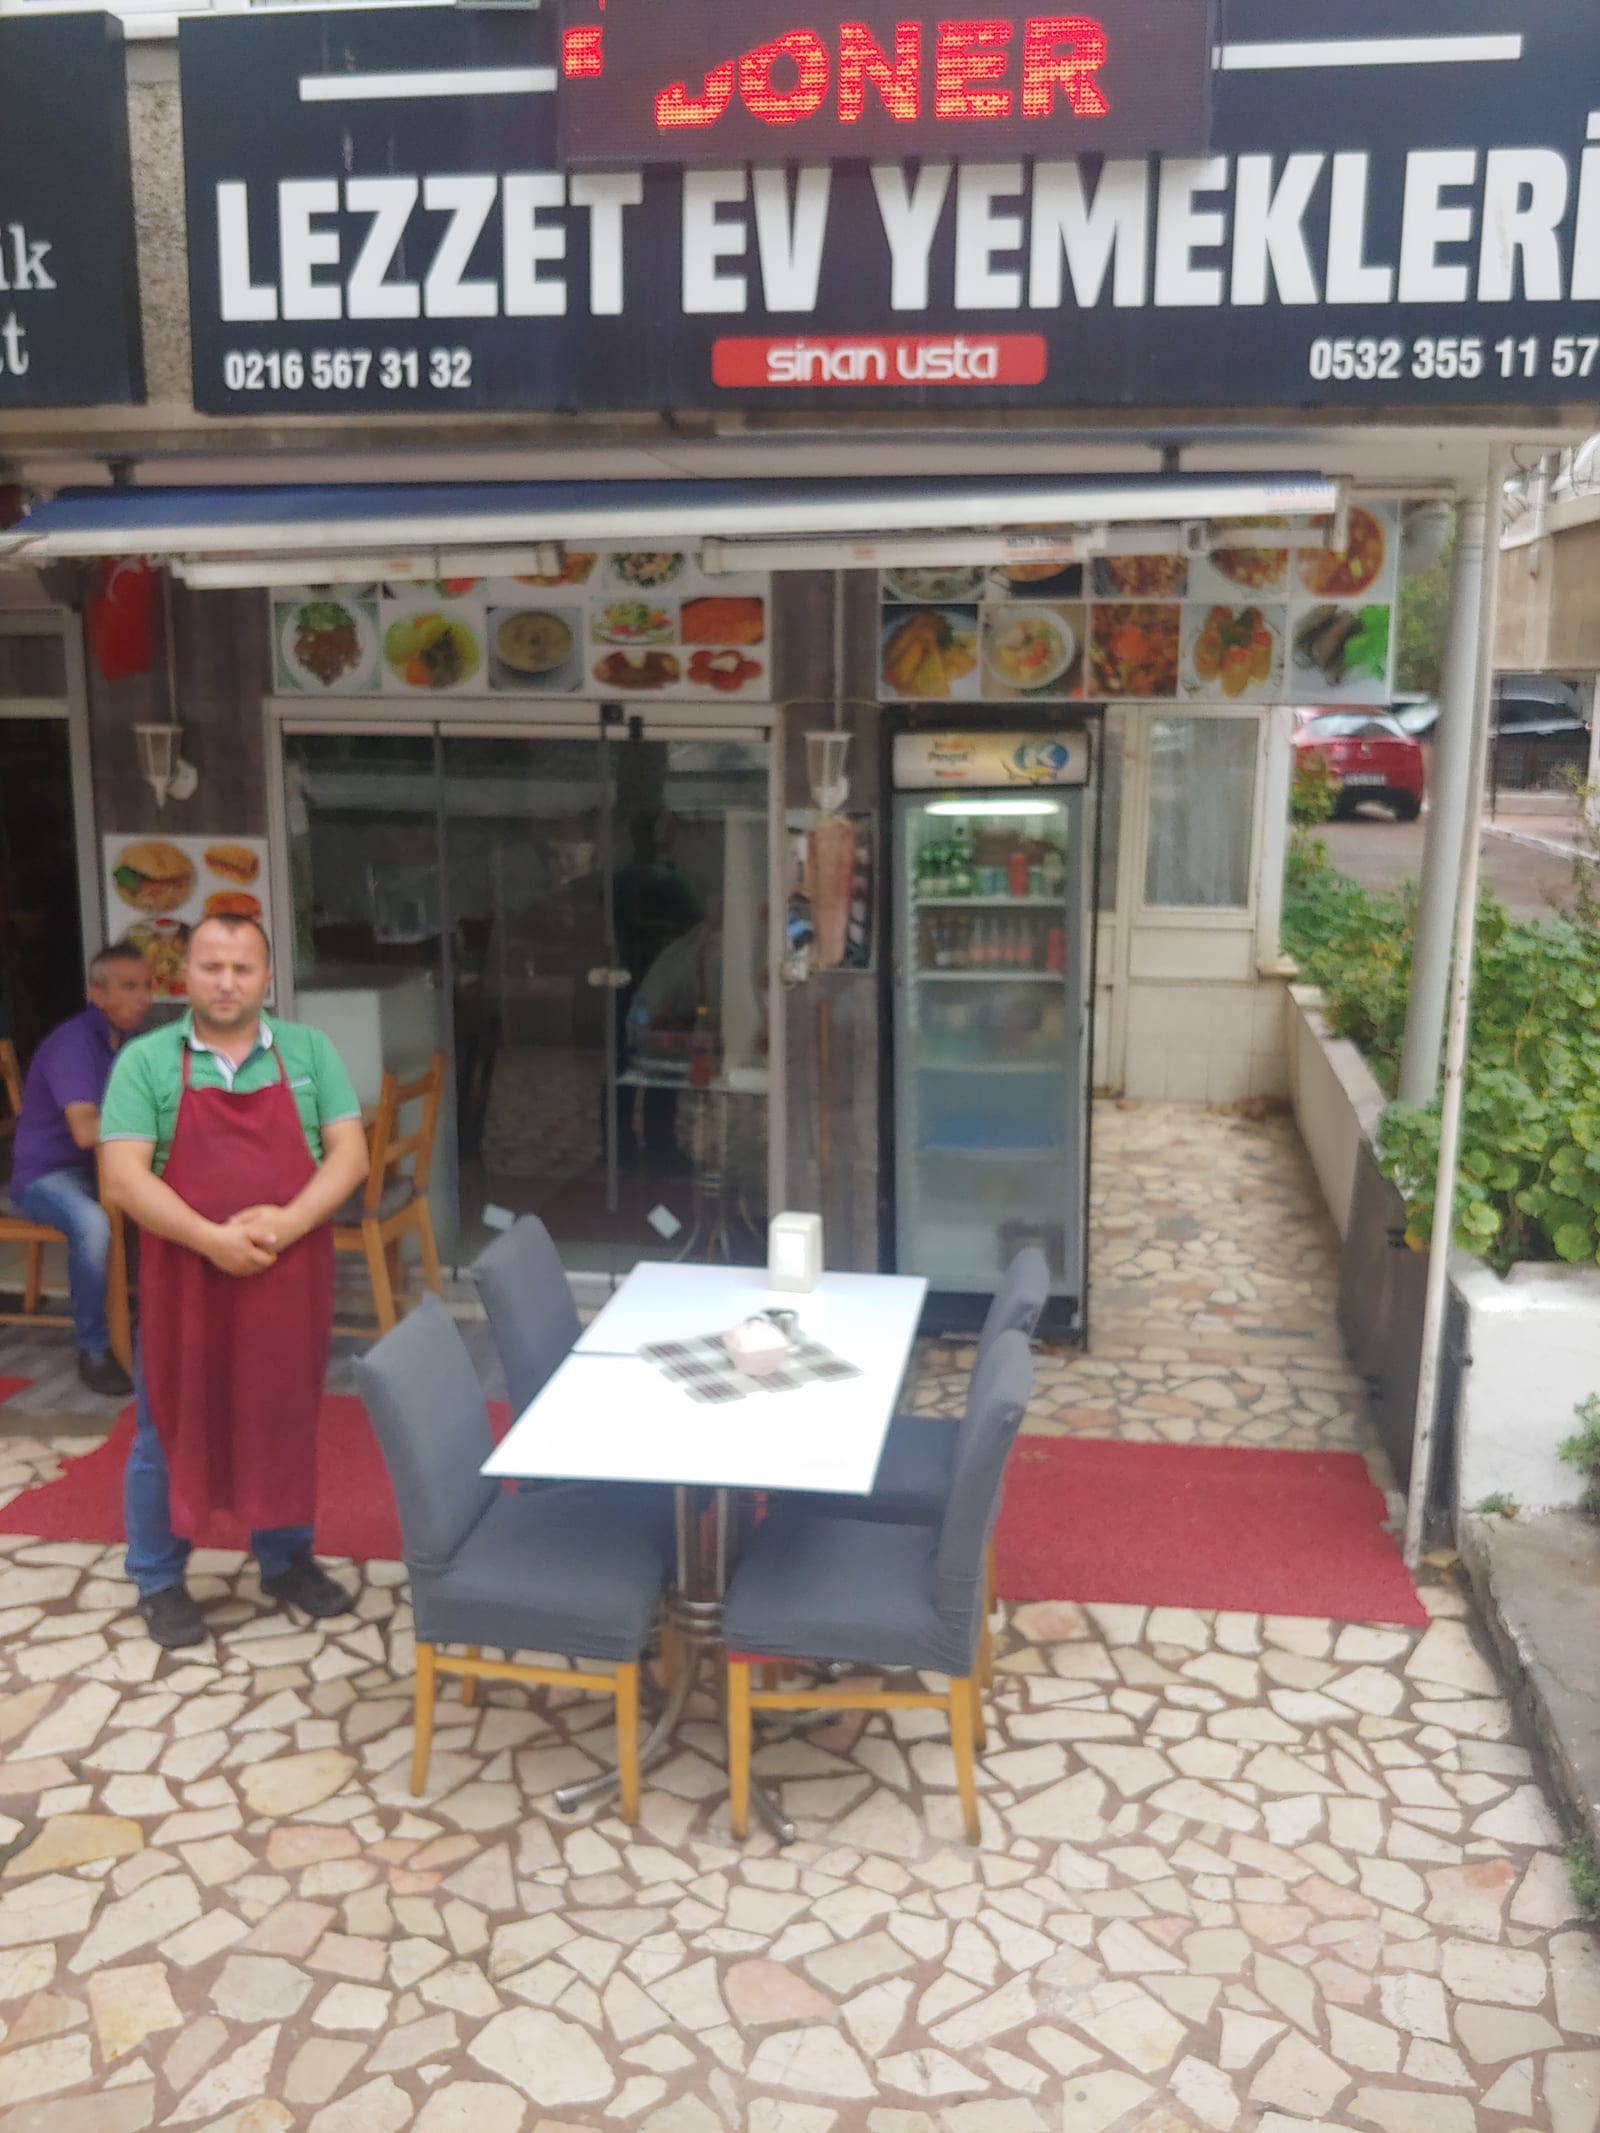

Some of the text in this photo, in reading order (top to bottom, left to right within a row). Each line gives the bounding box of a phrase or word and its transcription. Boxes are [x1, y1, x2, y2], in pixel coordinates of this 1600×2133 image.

[216, 170, 643, 320] LEZZET
[682, 166, 830, 313] EV
[224, 349, 472, 390] 0216 567 31 32
[766, 336, 998, 381] sinan usta
[1309, 335, 1600, 380] 0532 355 11 57
